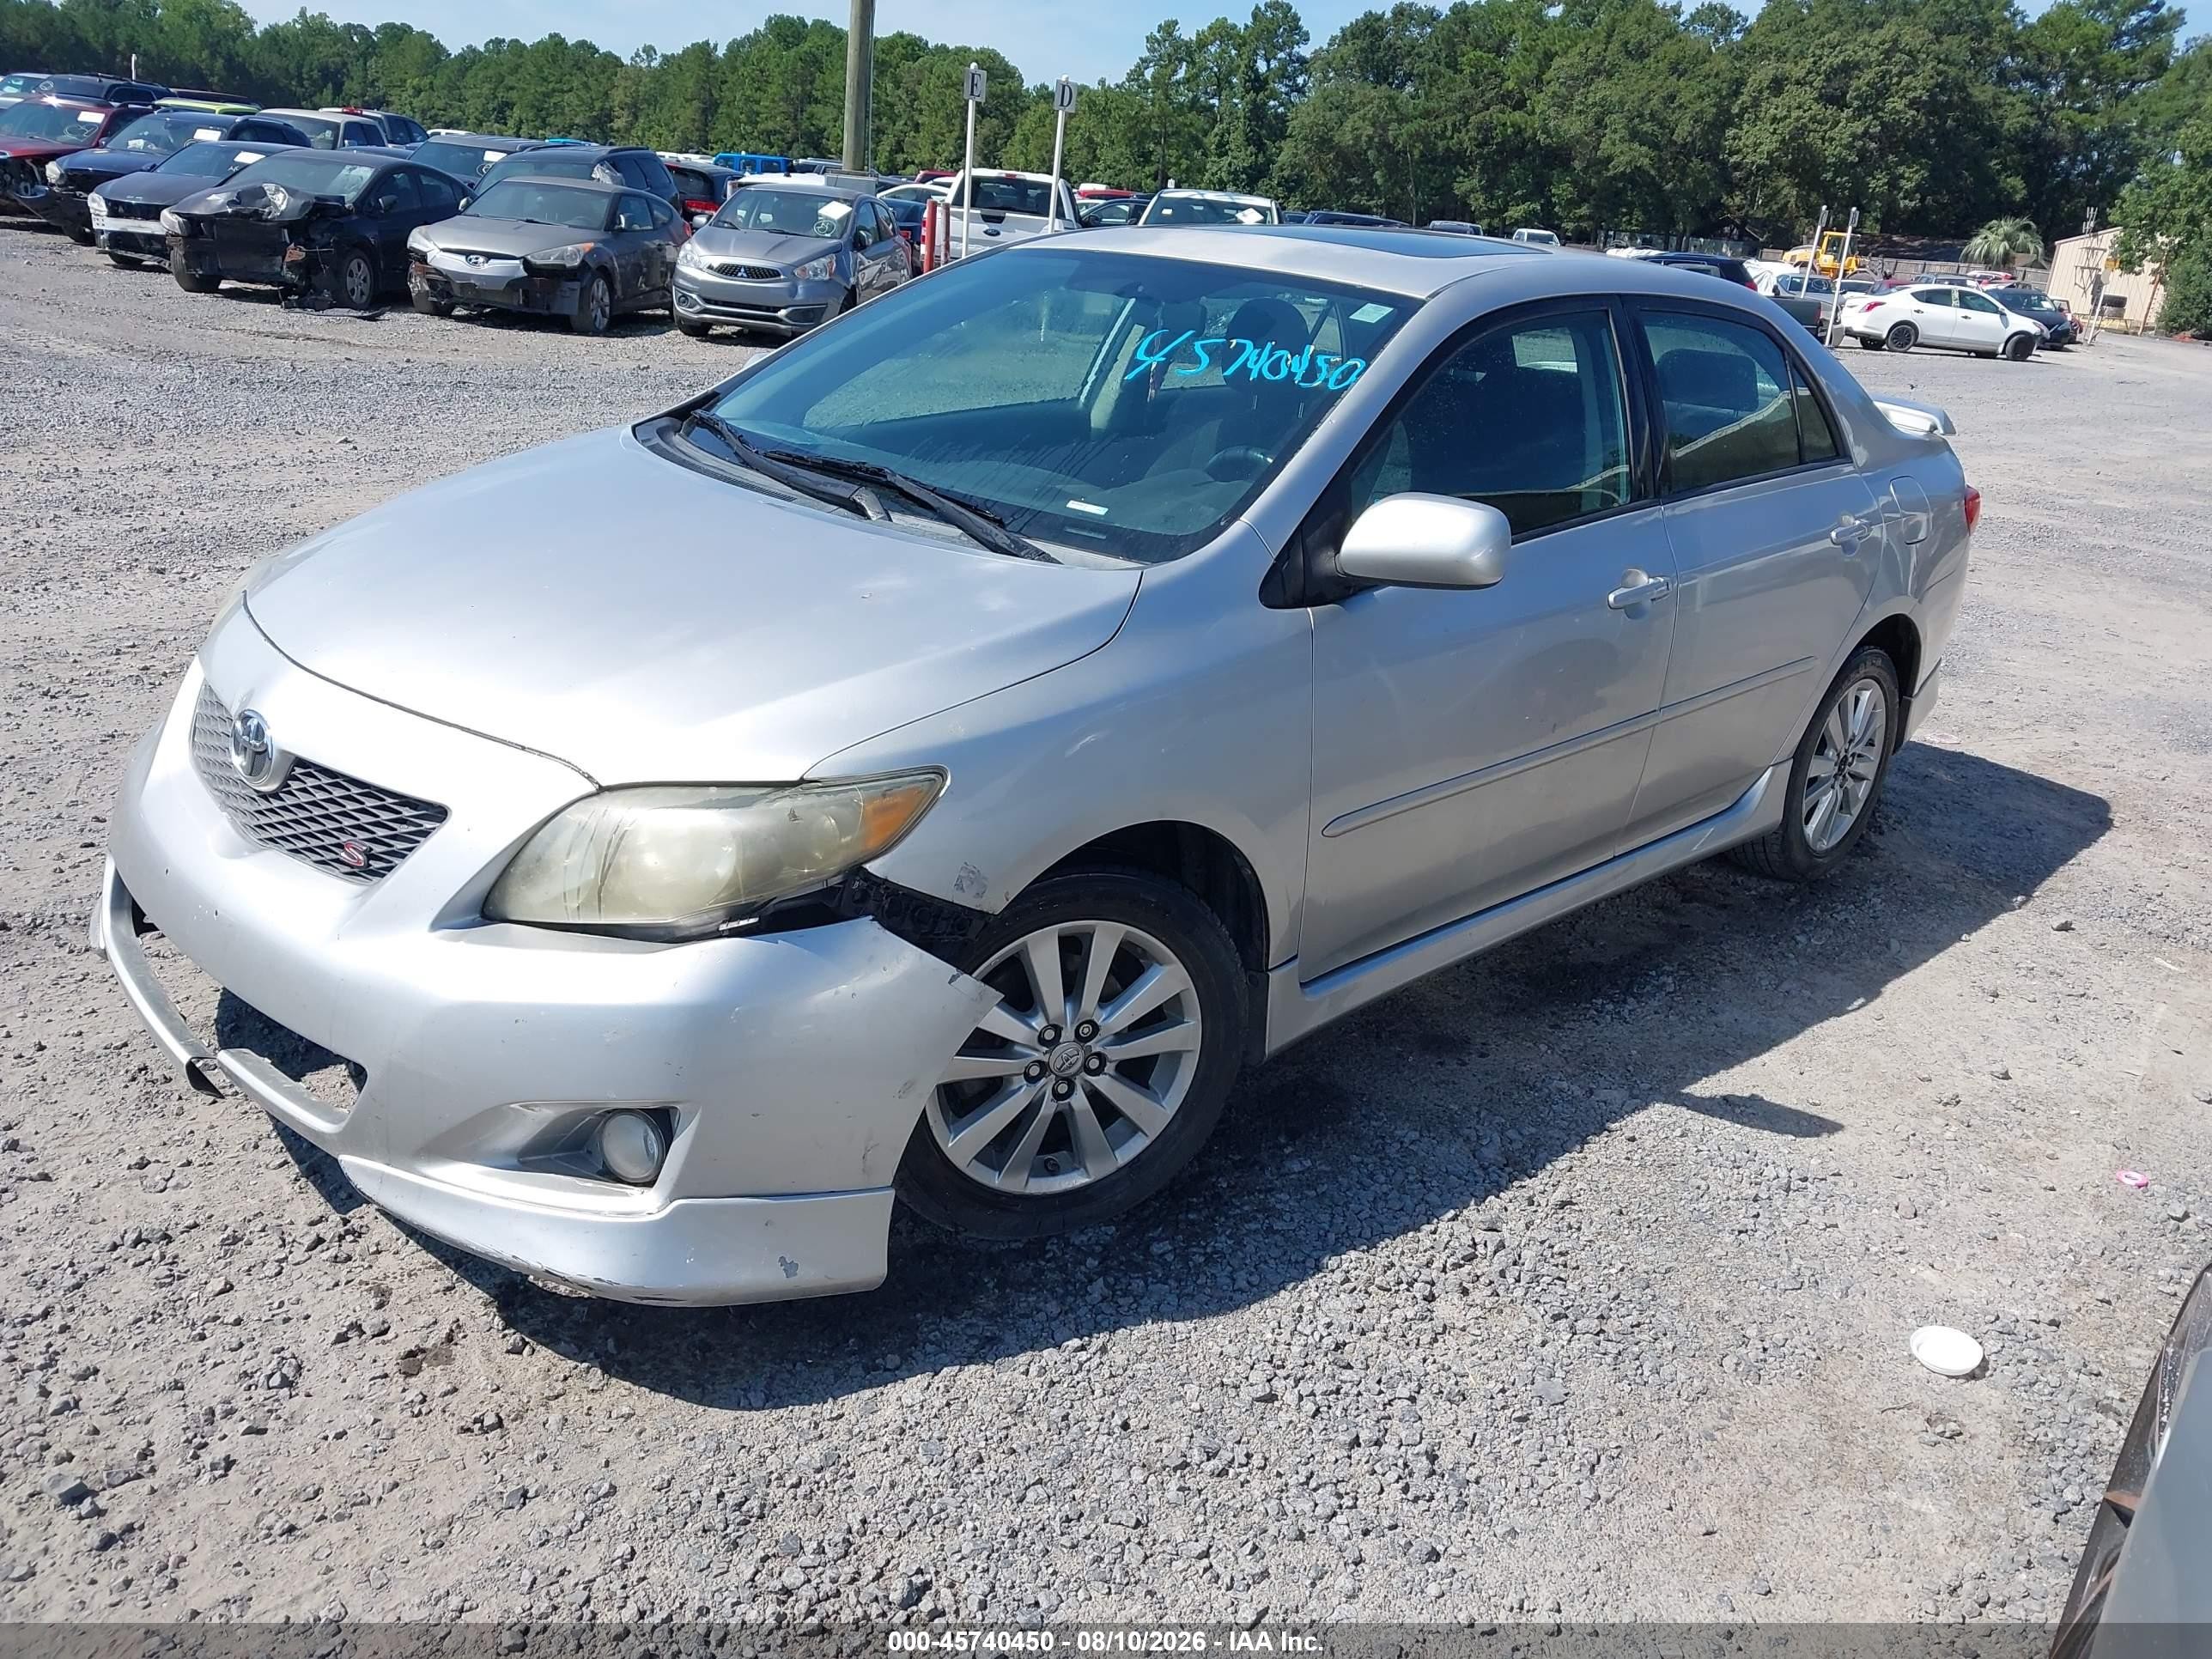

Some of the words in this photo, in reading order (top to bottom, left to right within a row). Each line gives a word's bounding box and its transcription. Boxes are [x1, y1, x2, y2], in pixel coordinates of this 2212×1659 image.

[969, 72, 981, 98] E
[1058, 83, 1073, 108] D
[340, 839, 367, 867] S
